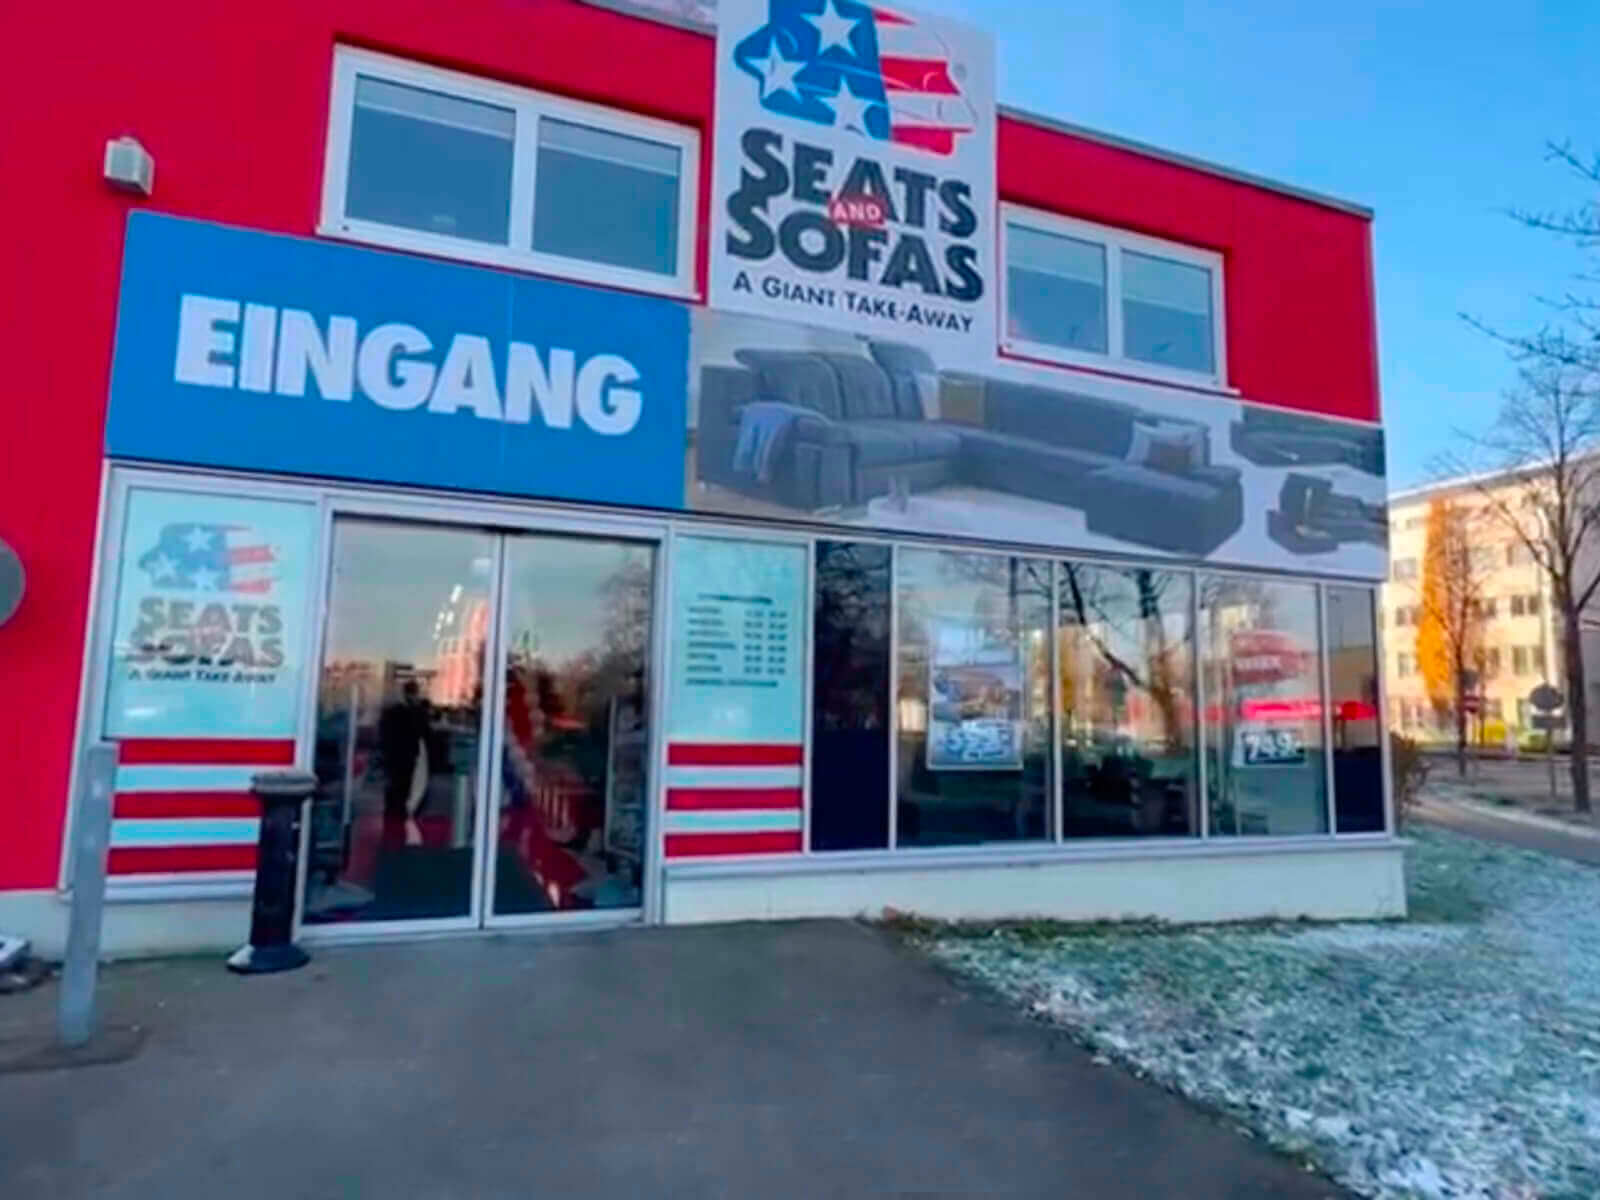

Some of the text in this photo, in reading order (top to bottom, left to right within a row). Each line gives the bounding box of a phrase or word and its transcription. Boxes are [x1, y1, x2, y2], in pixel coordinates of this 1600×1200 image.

[741, 127, 977, 238] SEATS
[832, 203, 882, 221] AND
[726, 188, 984, 302] SOFAS
[733, 271, 974, 333] A GIANT TAKE-AWAY
[174, 293, 644, 436] EINGANG
[139, 597, 283, 635] SEATS
